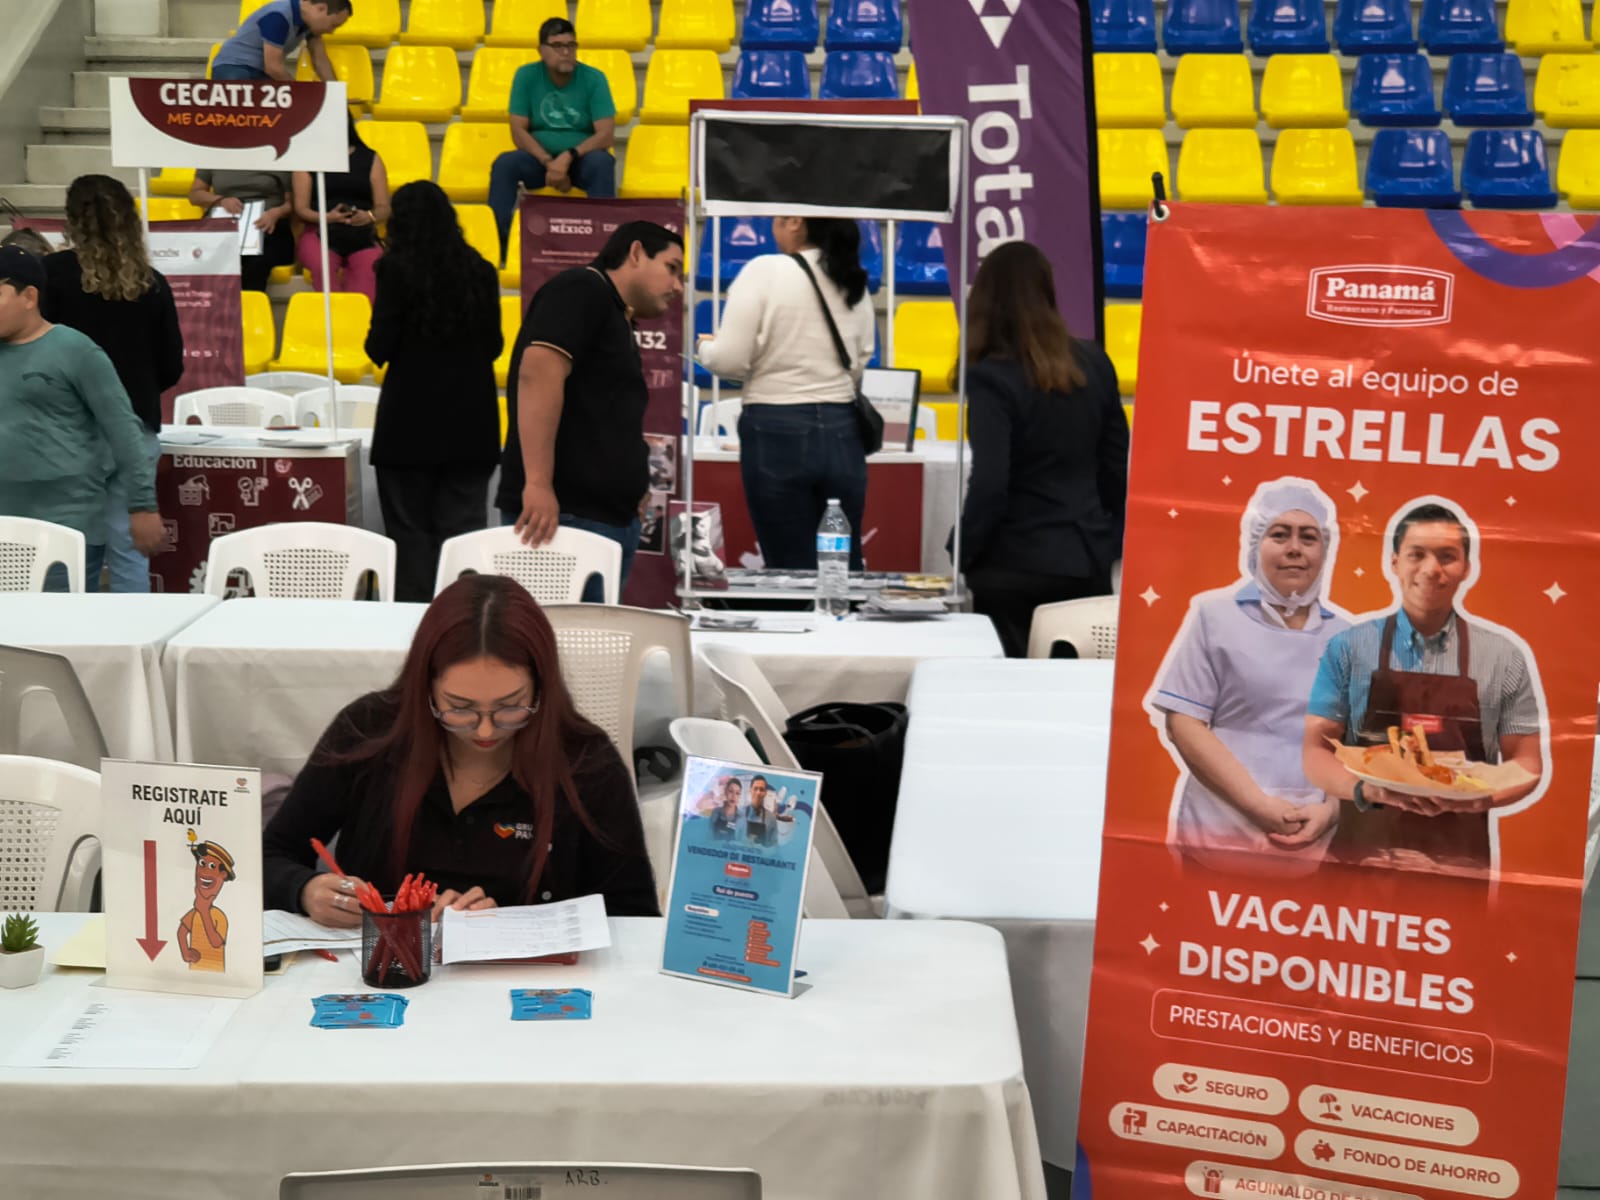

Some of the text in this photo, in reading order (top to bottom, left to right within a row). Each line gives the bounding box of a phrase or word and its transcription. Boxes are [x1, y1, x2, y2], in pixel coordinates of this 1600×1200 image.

[160, 83, 292, 108] CECATI 26
[167, 112, 191, 126] ME
[967, 64, 1034, 262] Tota
[550, 224, 593, 235] MÉXICO
[1326, 277, 1436, 301] Panamá
[1232, 350, 1519, 398] Únete al equipo de
[1187, 400, 1561, 472] ESTRELLAS
[132, 784, 228, 807] REGISTRATE
[163, 807, 202, 826] AQUÍ
[687, 845, 728, 859] VENDEDOR
[730, 852, 739, 861] DE
[741, 853, 797, 871] RESTAURANTE
[1208, 890, 1452, 954] VACANTES
[1178, 941, 1475, 1014] DISPONIBLES
[1169, 1005, 1474, 1065] PRESTACIONES Y BENEFICIOS
[1205, 1080, 1269, 1101] SEGURO
[1351, 1103, 1455, 1131] VACACIONES
[1156, 1119, 1268, 1147] CAPACITACIÓN
[1343, 1148, 1501, 1184] FONDO DE AHORRO
[1235, 1178, 1325, 1200] AGUINALDO
